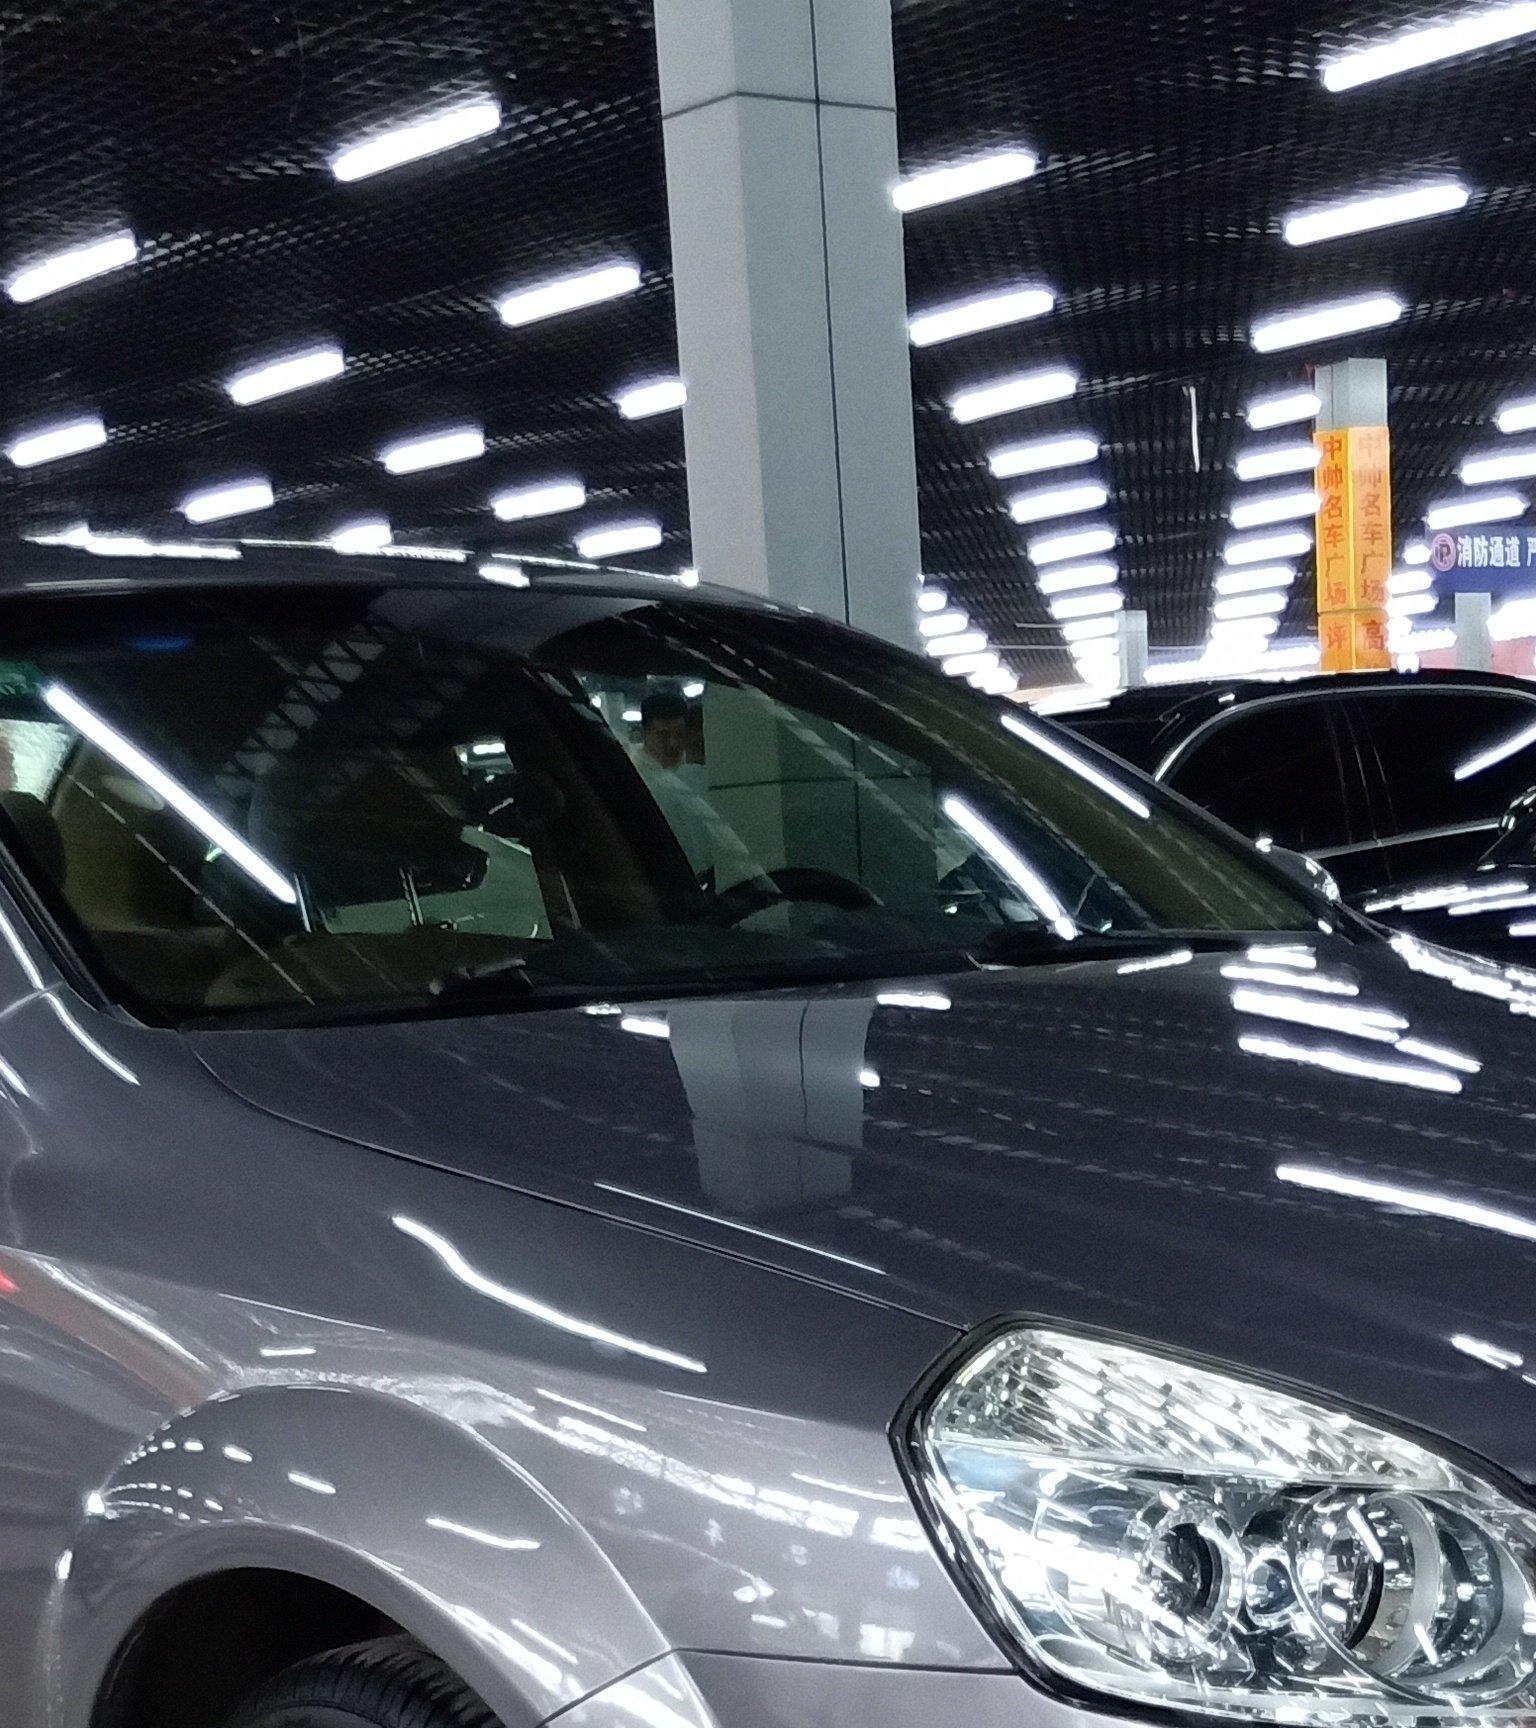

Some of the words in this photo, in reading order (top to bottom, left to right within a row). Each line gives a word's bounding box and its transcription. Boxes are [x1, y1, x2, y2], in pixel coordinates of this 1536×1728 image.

[1322, 435, 1347, 605] 中帅名车广场
[1457, 535, 1521, 567] 消防通道
